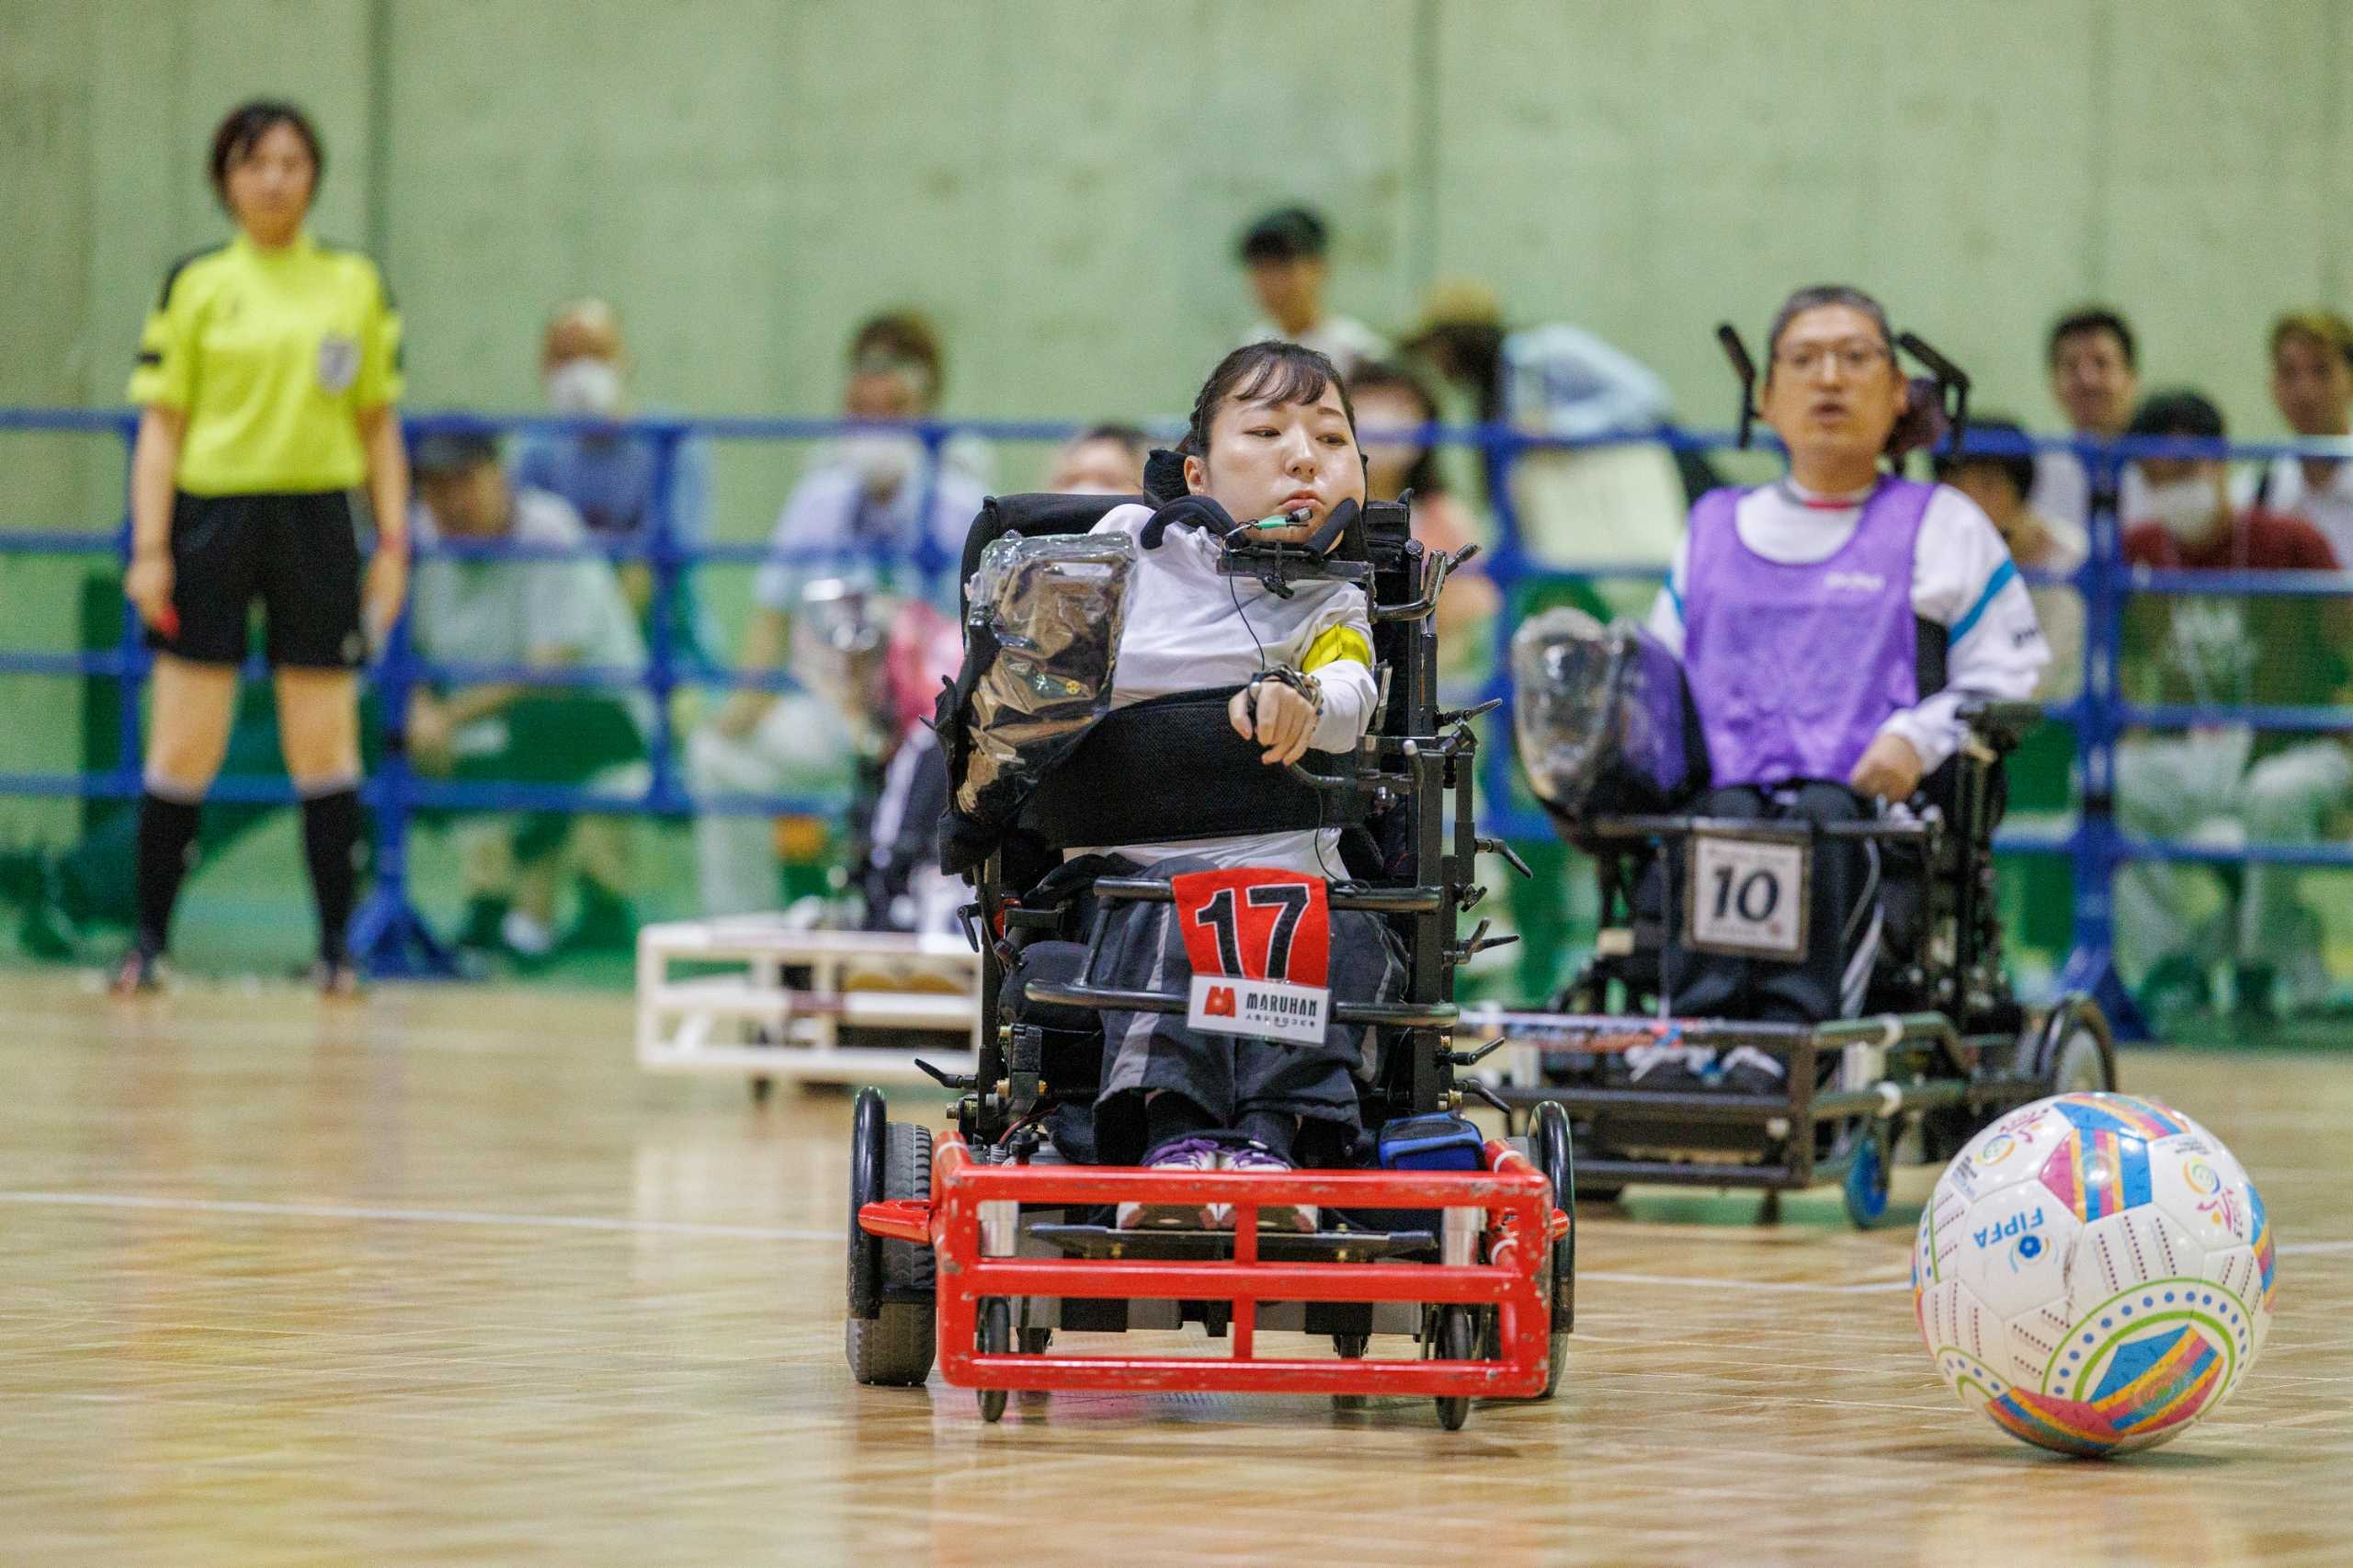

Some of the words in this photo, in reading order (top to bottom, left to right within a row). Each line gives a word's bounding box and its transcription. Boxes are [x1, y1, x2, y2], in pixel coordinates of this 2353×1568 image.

[1712, 863, 1779, 923] 10
[1195, 882, 1311, 980] 17
[1245, 992, 1318, 1017] MARUHAN
[1972, 1206, 2044, 1248] FIPFA
